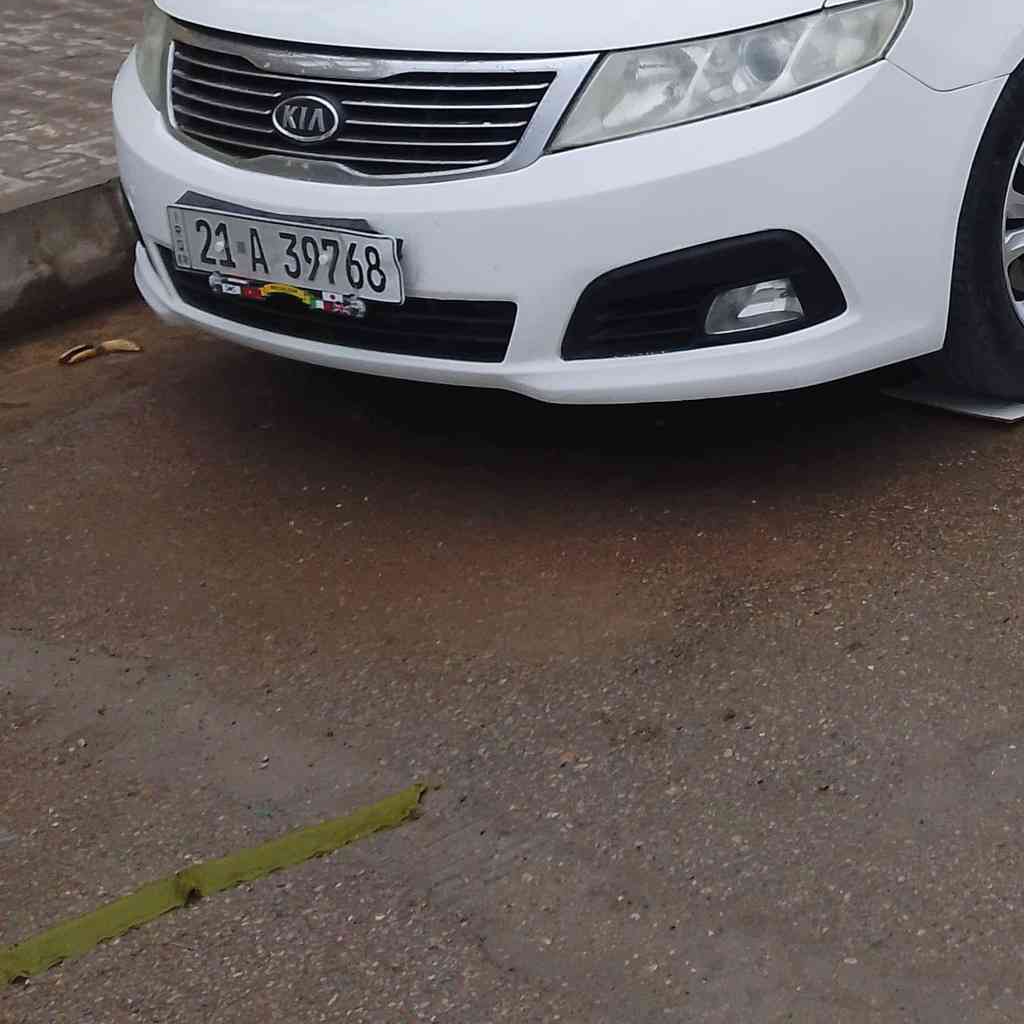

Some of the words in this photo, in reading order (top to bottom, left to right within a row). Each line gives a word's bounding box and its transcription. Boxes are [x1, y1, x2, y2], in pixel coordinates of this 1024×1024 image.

[283, 105, 325, 132] KIA
[196, 219, 236, 268] 21
[249, 228, 269, 274] A
[279, 232, 386, 293] 39768
